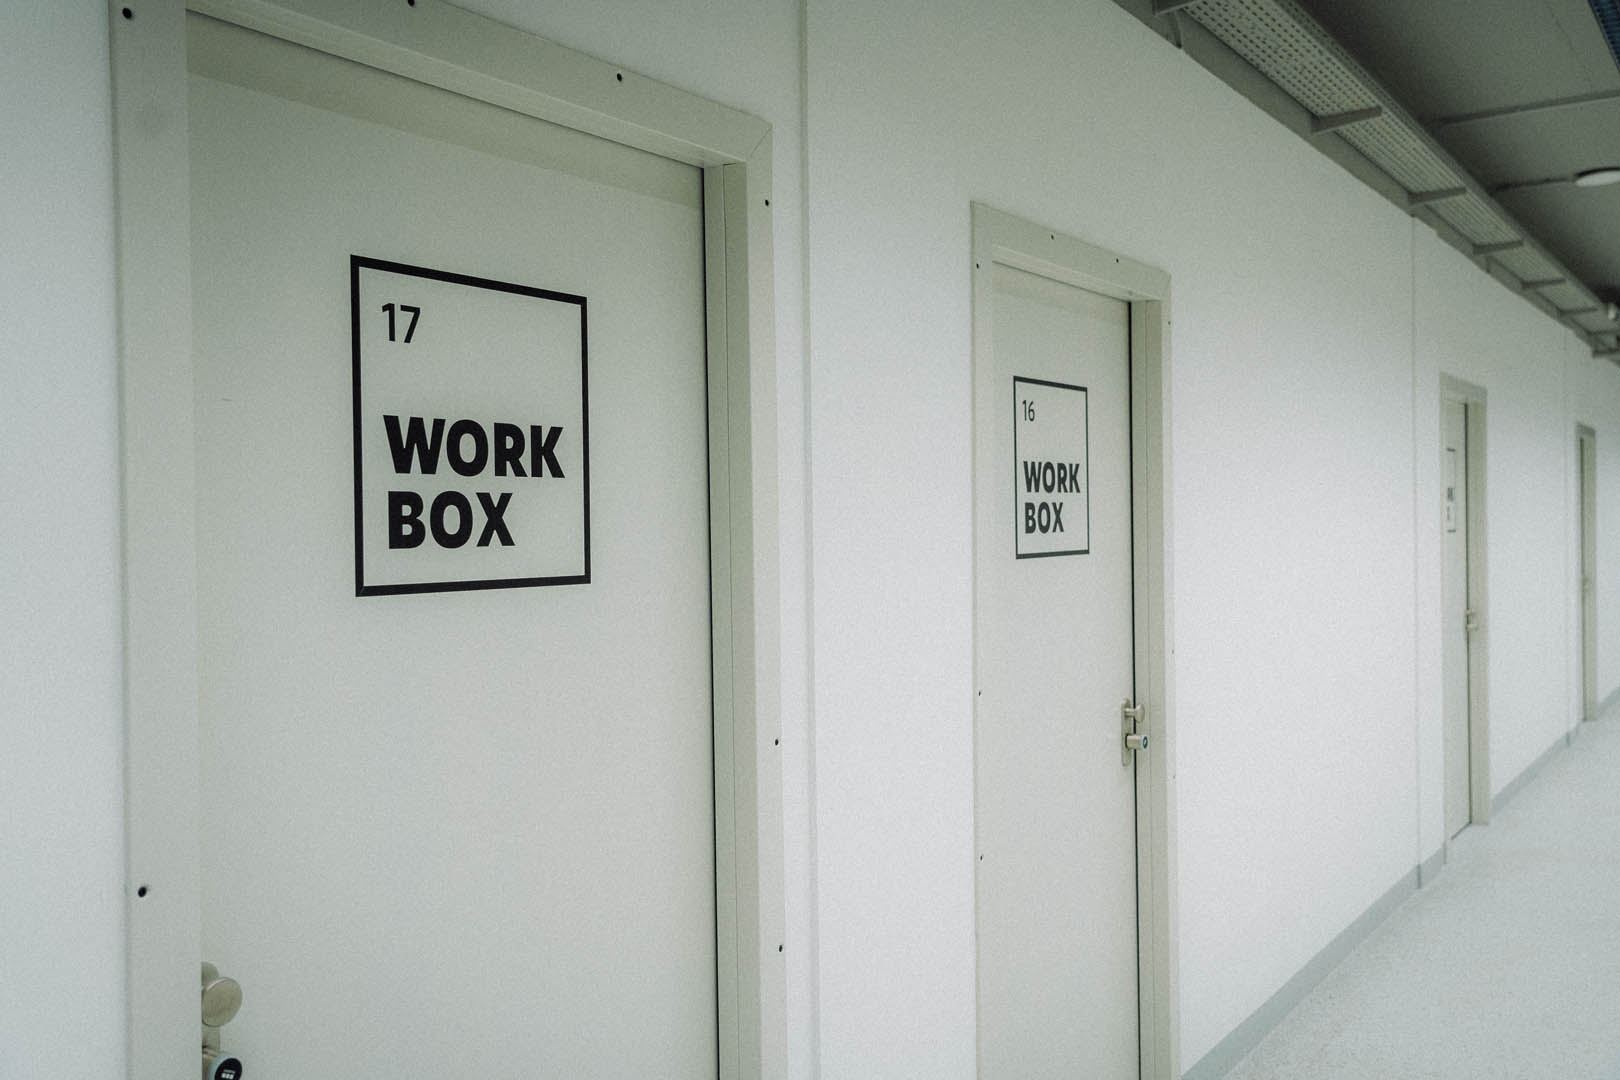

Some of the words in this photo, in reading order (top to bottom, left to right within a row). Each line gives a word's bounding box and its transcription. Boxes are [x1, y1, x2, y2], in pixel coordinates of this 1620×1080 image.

[382, 303, 421, 343] 17
[1022, 400, 1036, 422] 16
[383, 415, 565, 478] WORK
[1024, 461, 1081, 493] WORK
[388, 491, 516, 549] BOX
[1025, 502, 1065, 534] BOX
